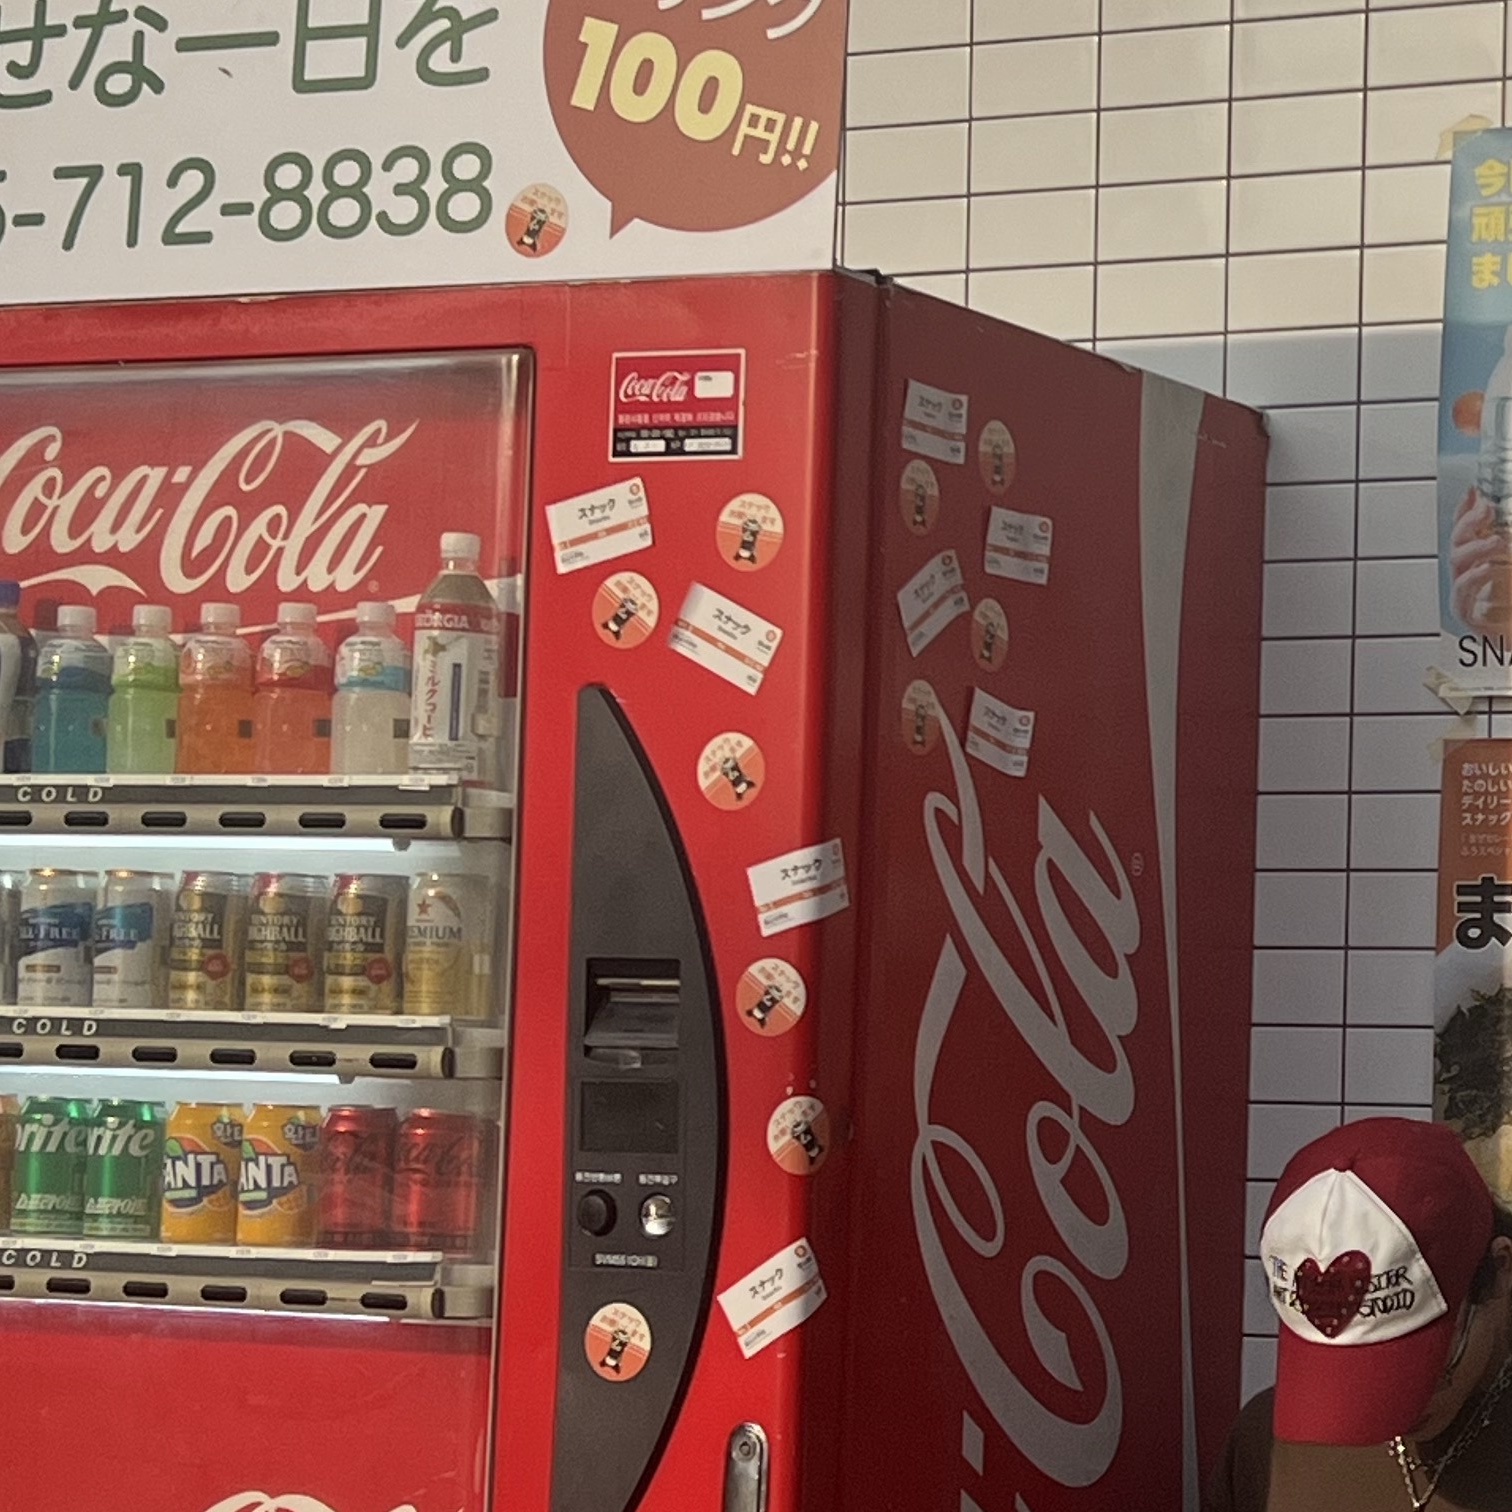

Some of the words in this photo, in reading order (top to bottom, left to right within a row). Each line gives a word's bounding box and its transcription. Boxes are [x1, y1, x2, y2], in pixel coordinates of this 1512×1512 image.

[570, 16, 820, 171] 100円!!
[0, 143, 492, 251] -712-8838
[17, 786, 103, 802] COLD
[12, 1018, 98, 1036] COLD
[15, 1114, 87, 1153] rite
[87, 1118, 156, 1158] rite
[2, 1249, 88, 1268] COLD
